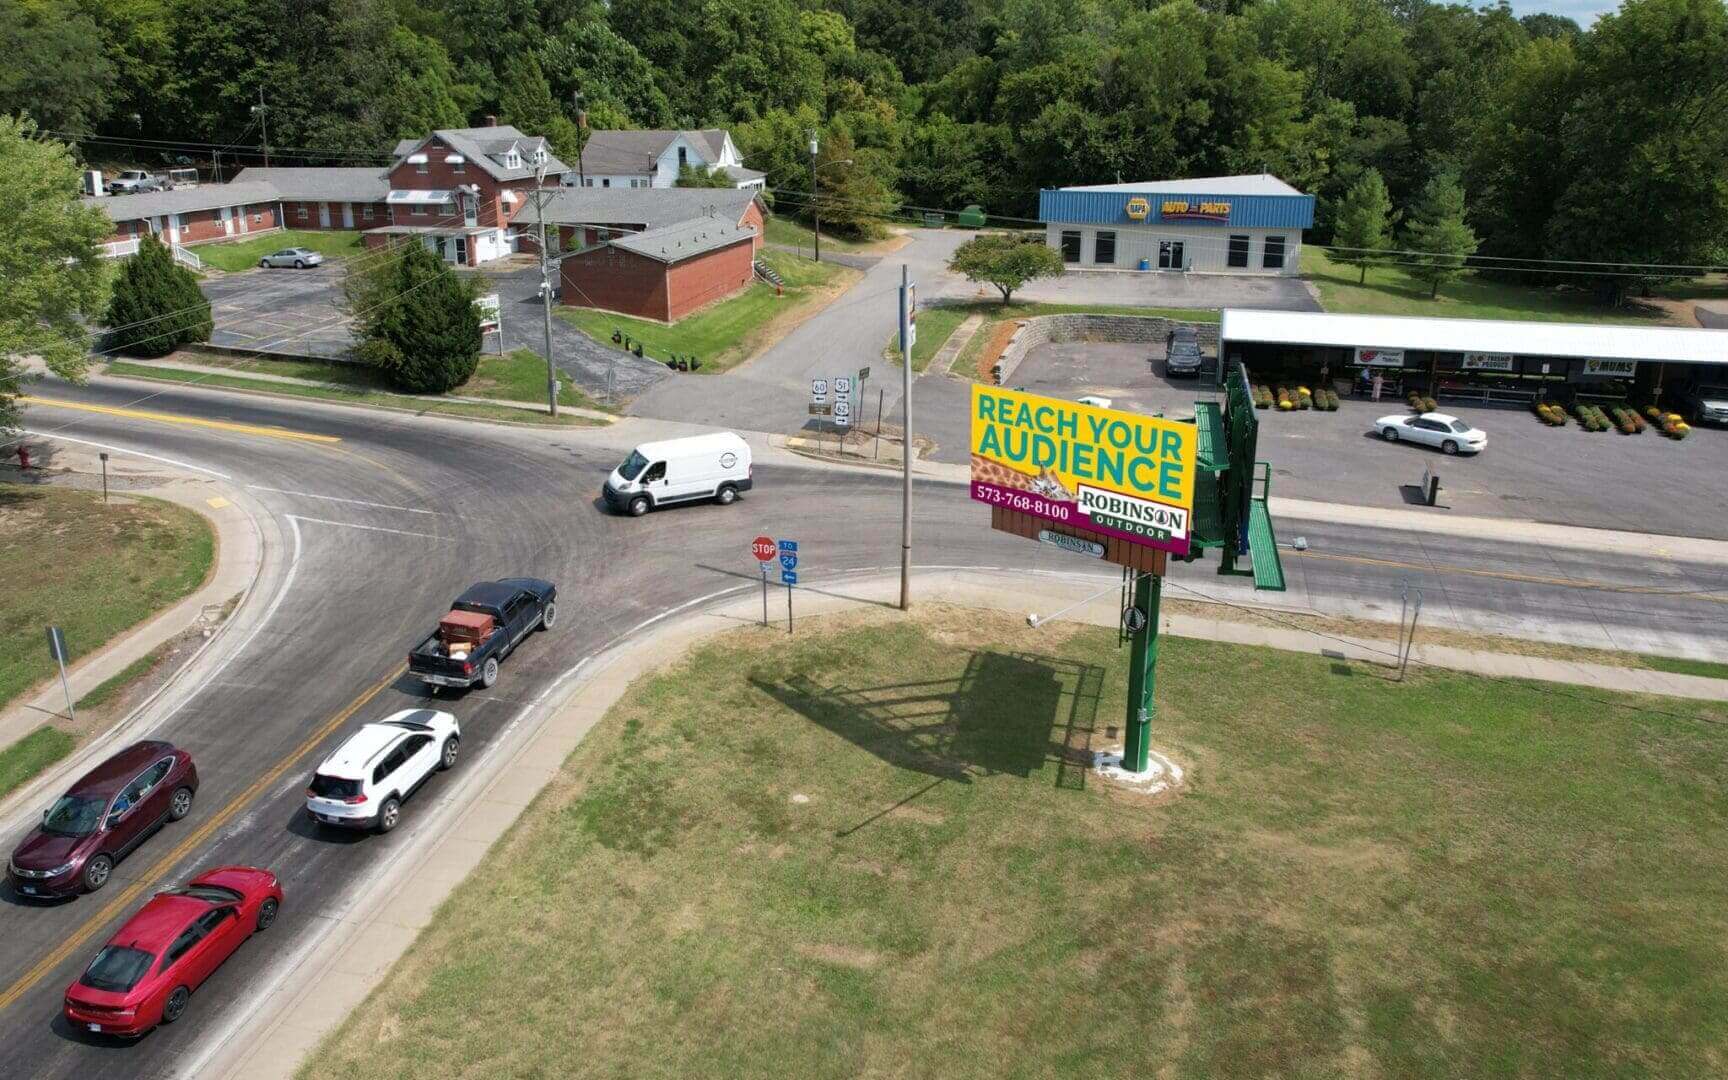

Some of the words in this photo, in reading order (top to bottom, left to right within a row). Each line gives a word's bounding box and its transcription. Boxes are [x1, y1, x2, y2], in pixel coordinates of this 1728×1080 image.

[1162, 201, 1189, 213] AUTO
[1199, 202, 1231, 214] PARTS
[1600, 361, 1633, 373] MUMS
[814, 383, 825, 391] 60
[837, 381, 847, 390] 51
[837, 405, 847, 414] 62
[979, 394, 1078, 439] REACH
[1087, 415, 1182, 461] YOUR
[979, 424, 1184, 500] AUDIENCE
[977, 485, 1069, 521] 573-768-8100
[1082, 491, 1183, 530] ROBINSON
[1096, 514, 1165, 540] OUTDOOR
[752, 543, 775, 555] STOP
[782, 556, 794, 566] 24
